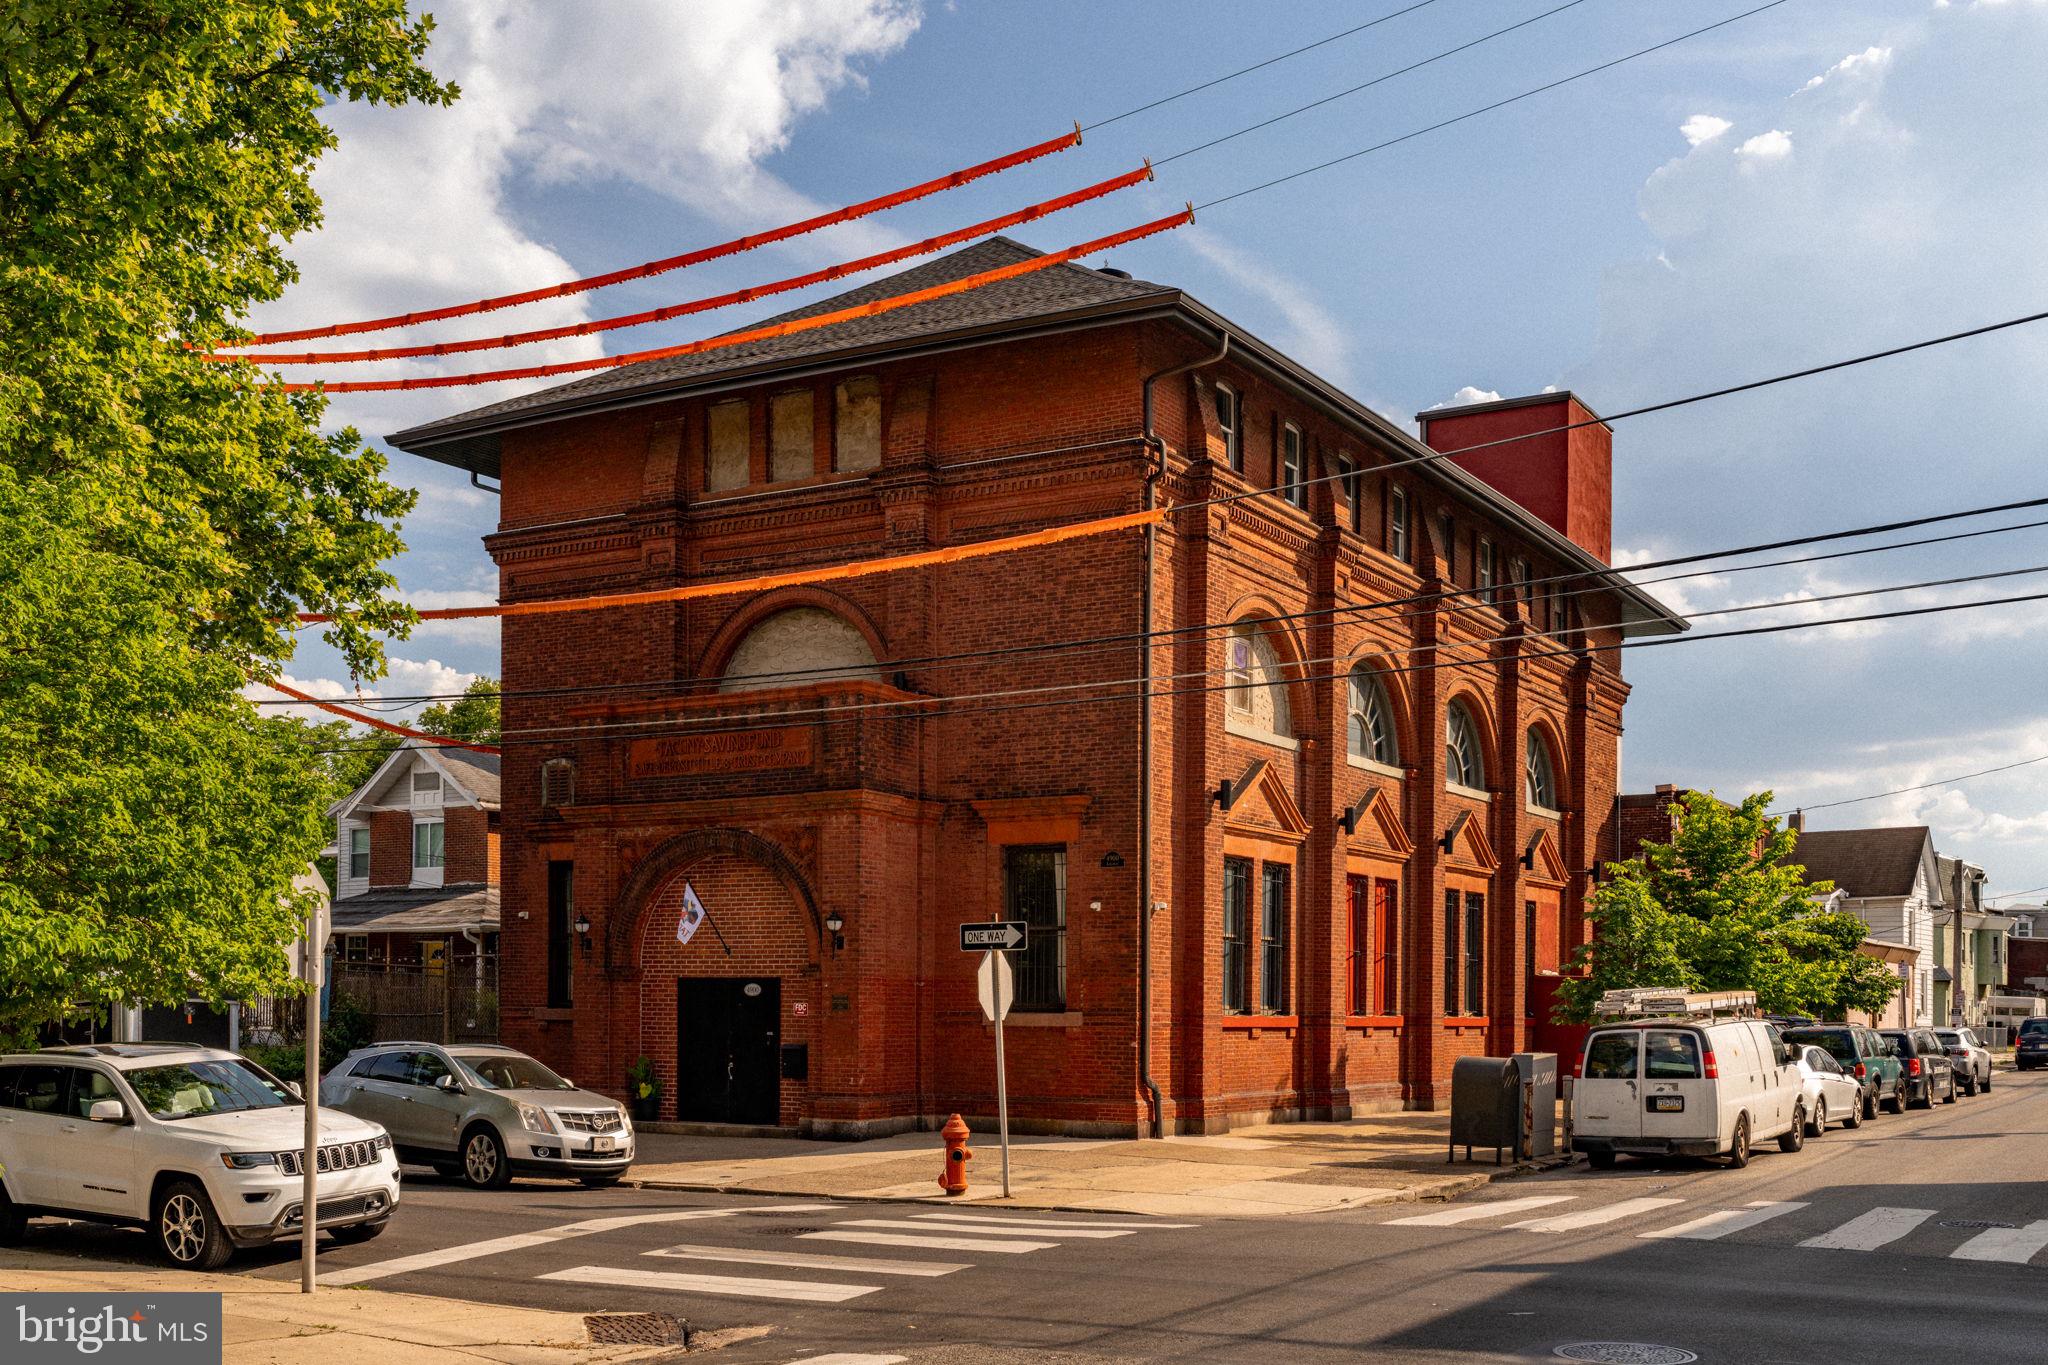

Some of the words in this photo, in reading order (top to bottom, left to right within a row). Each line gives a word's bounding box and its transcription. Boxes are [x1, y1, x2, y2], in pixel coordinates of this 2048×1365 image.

[967, 932, 985, 943] ONE
[987, 931, 1006, 942] WAY
[795, 1003, 807, 1011] FDC
